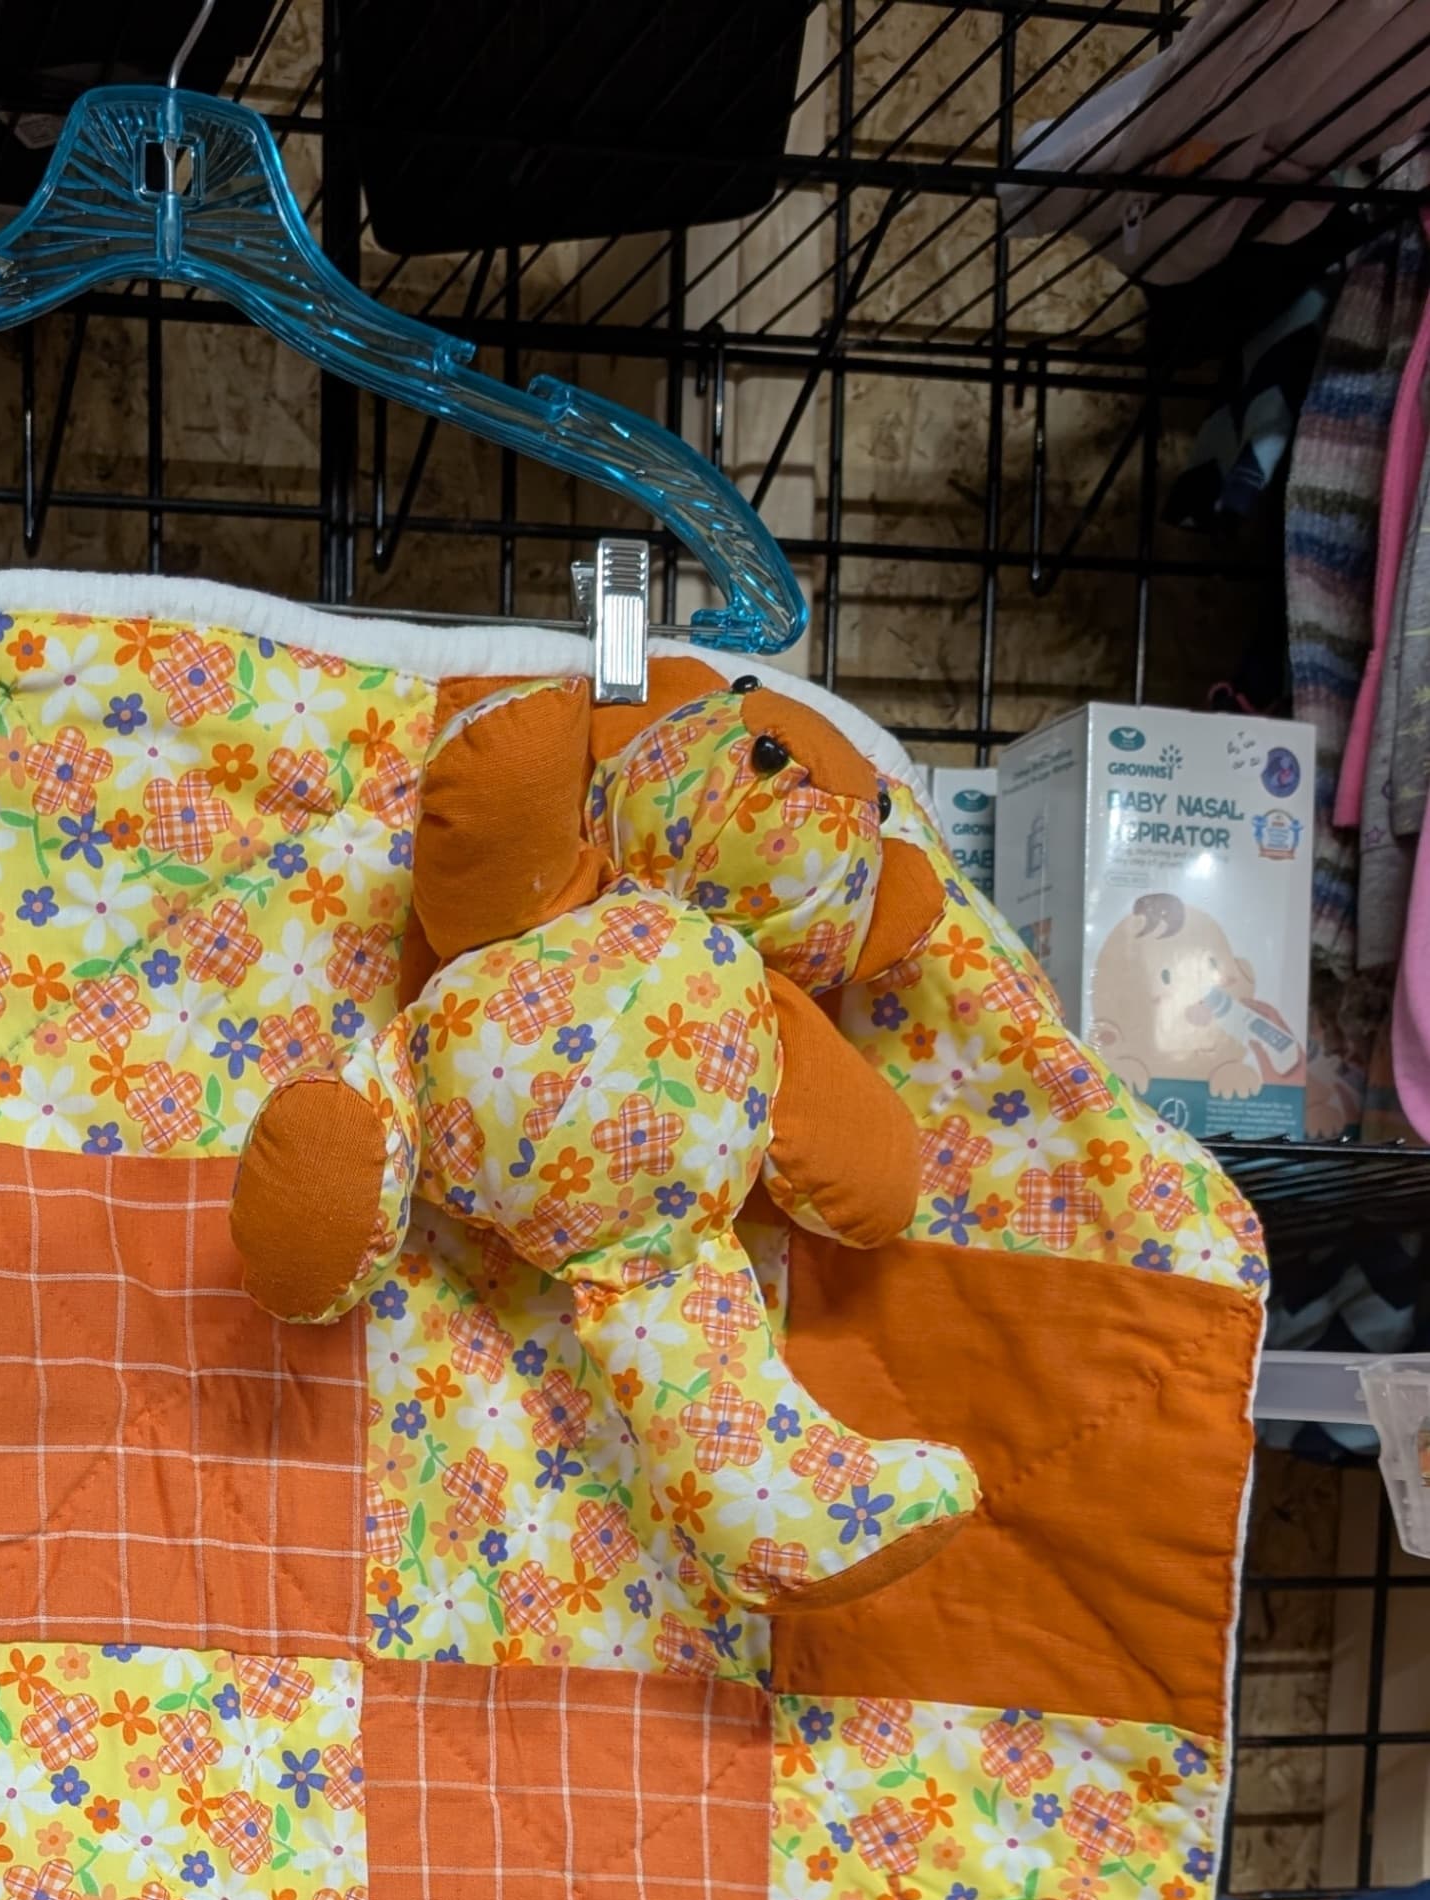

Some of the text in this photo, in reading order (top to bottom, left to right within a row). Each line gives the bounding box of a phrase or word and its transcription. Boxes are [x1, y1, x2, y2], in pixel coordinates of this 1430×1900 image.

[1107, 789, 1245, 821] BABY NASAL
[1109, 820, 1231, 849] SPIRATOR
